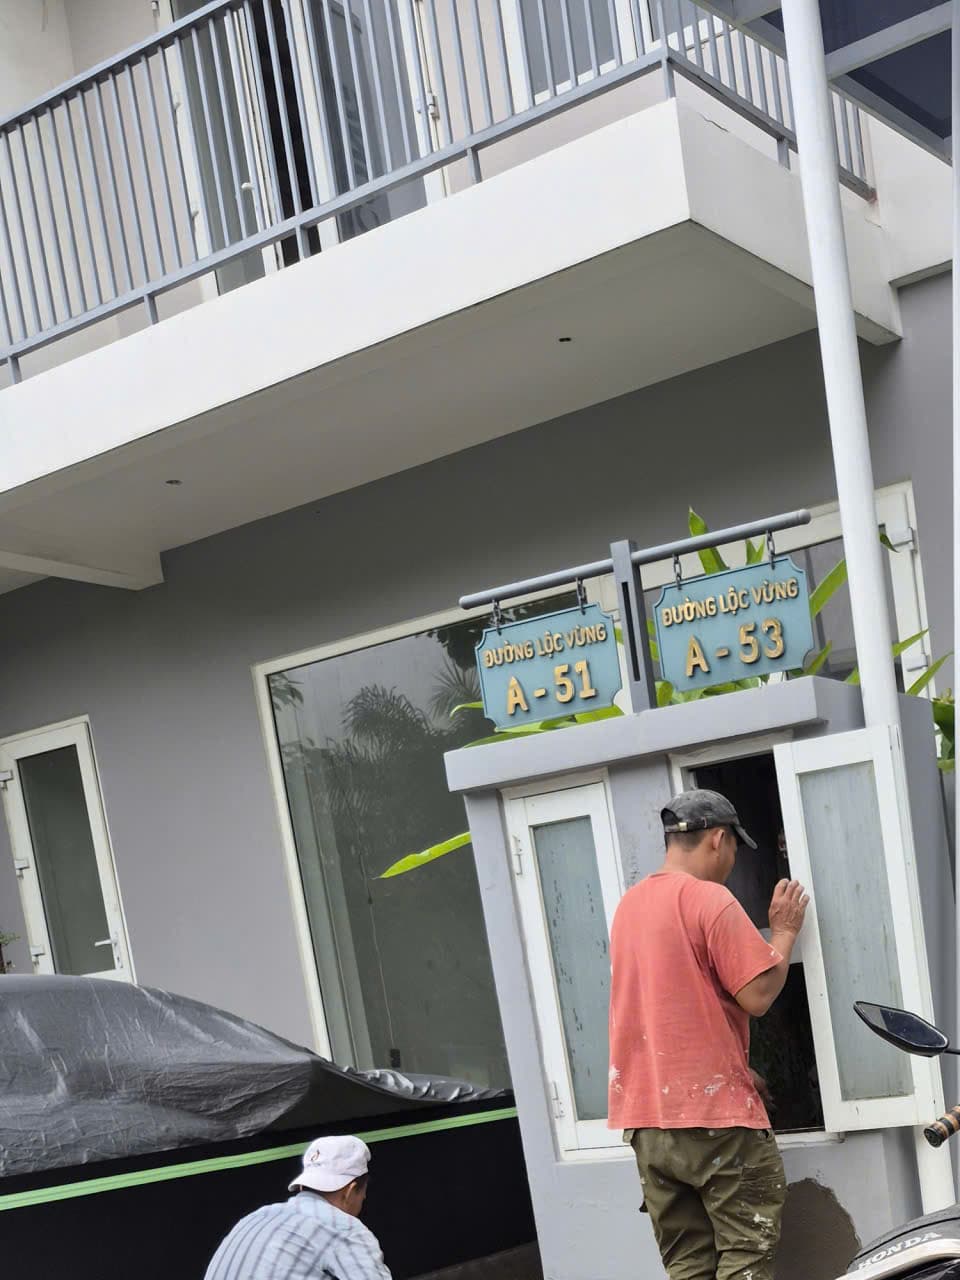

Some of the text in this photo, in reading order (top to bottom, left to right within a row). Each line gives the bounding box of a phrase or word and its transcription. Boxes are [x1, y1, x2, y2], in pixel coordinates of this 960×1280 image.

[661, 577, 798, 627] ĐƯỜNG LỘC VỪNG
[483, 622, 607, 669] ĐƯỜNG LỘC VỪNG
[858, 1232, 943, 1270] HONDA
